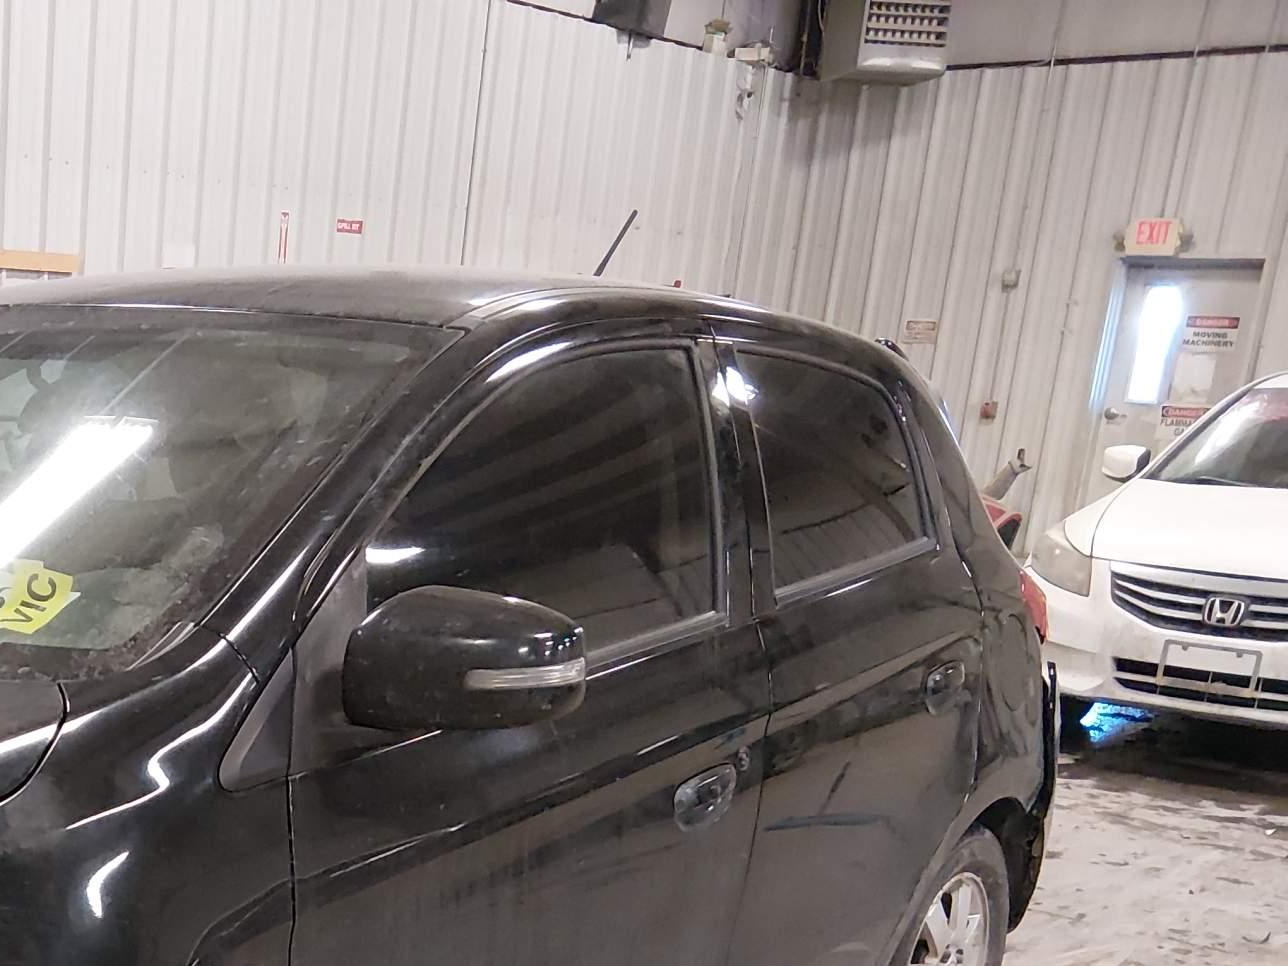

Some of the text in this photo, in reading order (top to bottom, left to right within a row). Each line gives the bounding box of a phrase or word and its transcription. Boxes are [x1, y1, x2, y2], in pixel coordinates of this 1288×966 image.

[1136, 220, 1172, 245] EXIT
[1182, 339, 1234, 348] MACHINERY
[1192, 331, 1228, 339] MOVING
[0, 573, 57, 623] VIC
